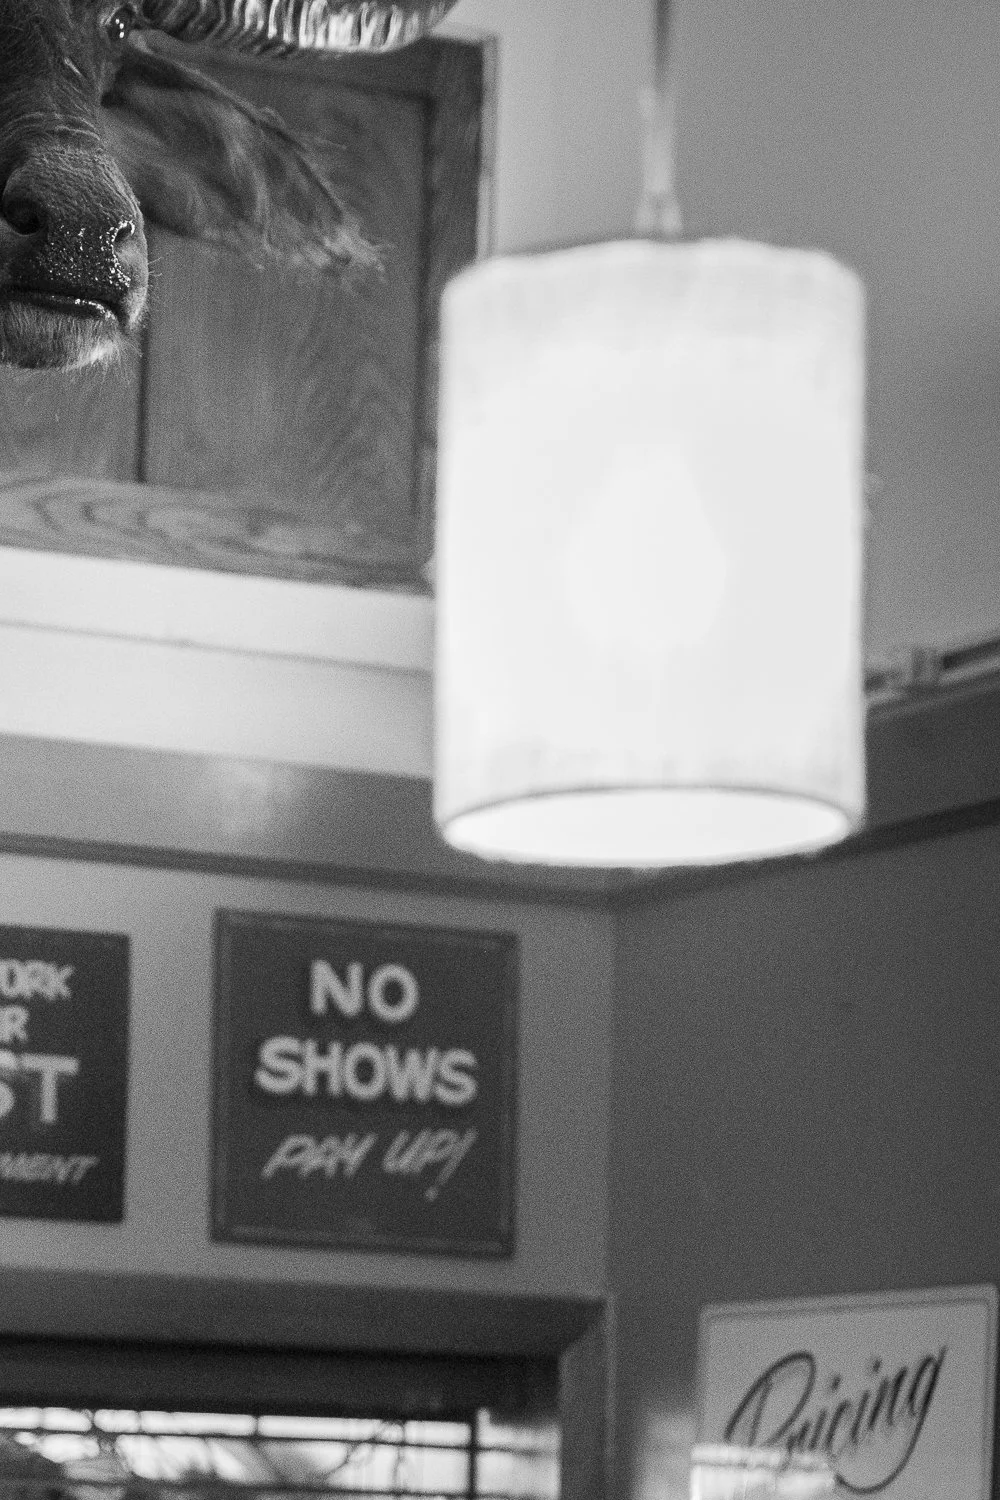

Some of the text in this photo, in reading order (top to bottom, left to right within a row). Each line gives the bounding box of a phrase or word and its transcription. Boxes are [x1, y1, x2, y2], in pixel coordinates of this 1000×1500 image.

[310, 958, 420, 1024] NO
[253, 1035, 479, 1107] SHOWS
[260, 1127, 479, 1201] PAY UP!
[722, 1345, 950, 1495] Pricing
